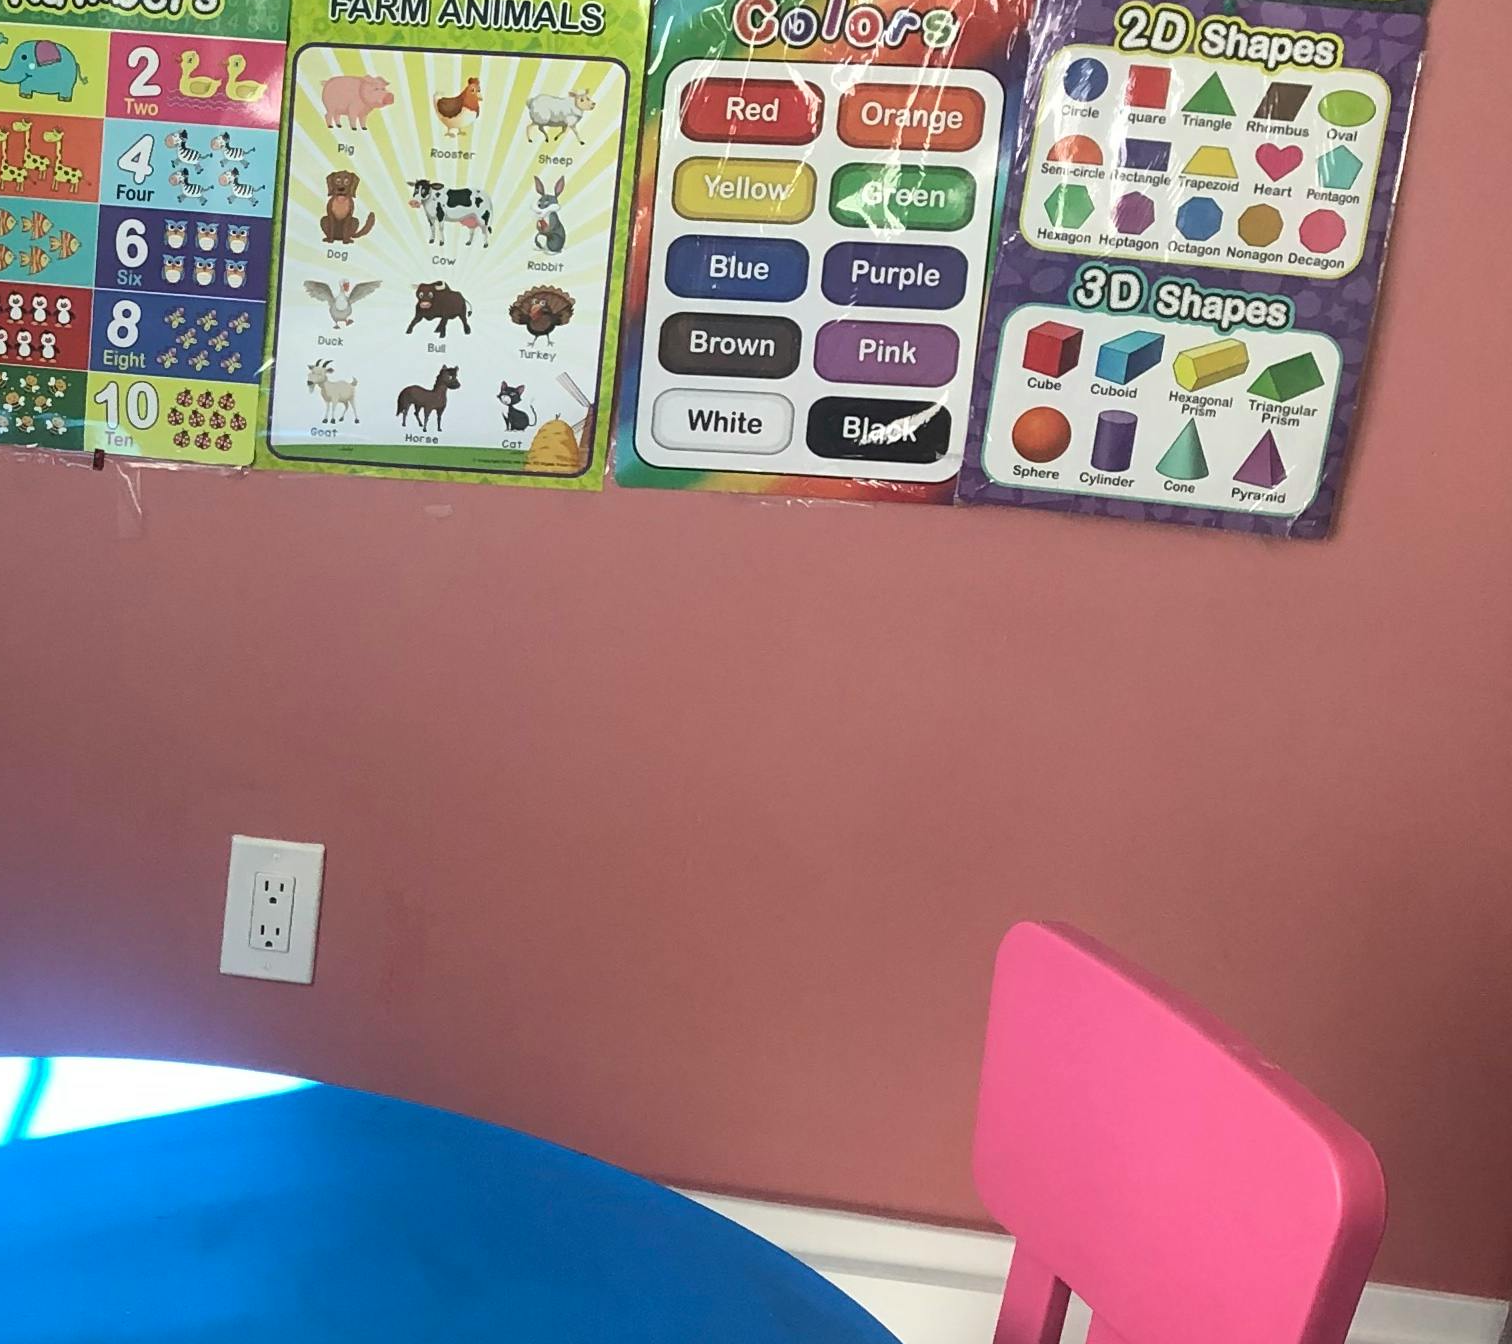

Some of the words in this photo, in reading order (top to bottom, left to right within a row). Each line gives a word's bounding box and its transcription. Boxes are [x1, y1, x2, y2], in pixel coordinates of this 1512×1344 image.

[1116, 7, 1189, 52] 2D
[1200, 17, 1338, 69] Shapes
[127, 46, 162, 98] 2
[124, 99, 159, 116] Two
[726, 96, 780, 123] Red
[861, 102, 964, 131] Orange
[1181, 115, 1232, 132] Triangle
[1246, 121, 1310, 138] Rhombus
[1327, 128, 1358, 141] Oval
[337, 142, 355, 156] Pig
[430, 148, 475, 161] Rooster
[117, 134, 155, 184] 4
[538, 154, 574, 167] Sheep
[116, 185, 155, 202] Four
[704, 175, 792, 201] Yellow
[1253, 183, 1292, 198] Heart
[1307, 187, 1360, 205] Pentagon
[115, 218, 149, 269] 6
[1037, 227, 1092, 246] Hexagon
[327, 249, 348, 261] Dog
[432, 255, 456, 267] Cow
[1226, 247, 1283, 264] Nonagon
[1288, 253, 1345, 270] Decagon
[527, 260, 564, 272] Rabbit
[709, 255, 769, 280] Blue
[117, 269, 143, 286] Six
[851, 260, 941, 290] Purple
[1073, 266, 1143, 312] 3D
[1156, 282, 1290, 329] Shapes
[106, 300, 142, 349] 8
[317, 336, 344, 347] Duck
[427, 342, 446, 353] Bull
[690, 331, 776, 358] Brown
[103, 349, 146, 369] Eight
[519, 349, 556, 363] Turkey
[859, 339, 917, 365] Pink
[1027, 378, 1062, 392] Cube
[1090, 383, 1137, 399] Cuboid
[94, 380, 160, 430] 10
[1169, 391, 1234, 409] Hexagonal
[1248, 399, 1318, 417] Triangular
[1181, 404, 1216, 418] Prism
[688, 408, 763, 434] White
[1261, 412, 1300, 428] Prism
[404, 433, 439, 445] Horse
[501, 440, 522, 450] Cat
[1013, 465, 1060, 482] Sphere
[1079, 472, 1135, 489] Cylinder
[1163, 479, 1195, 493] Cone
